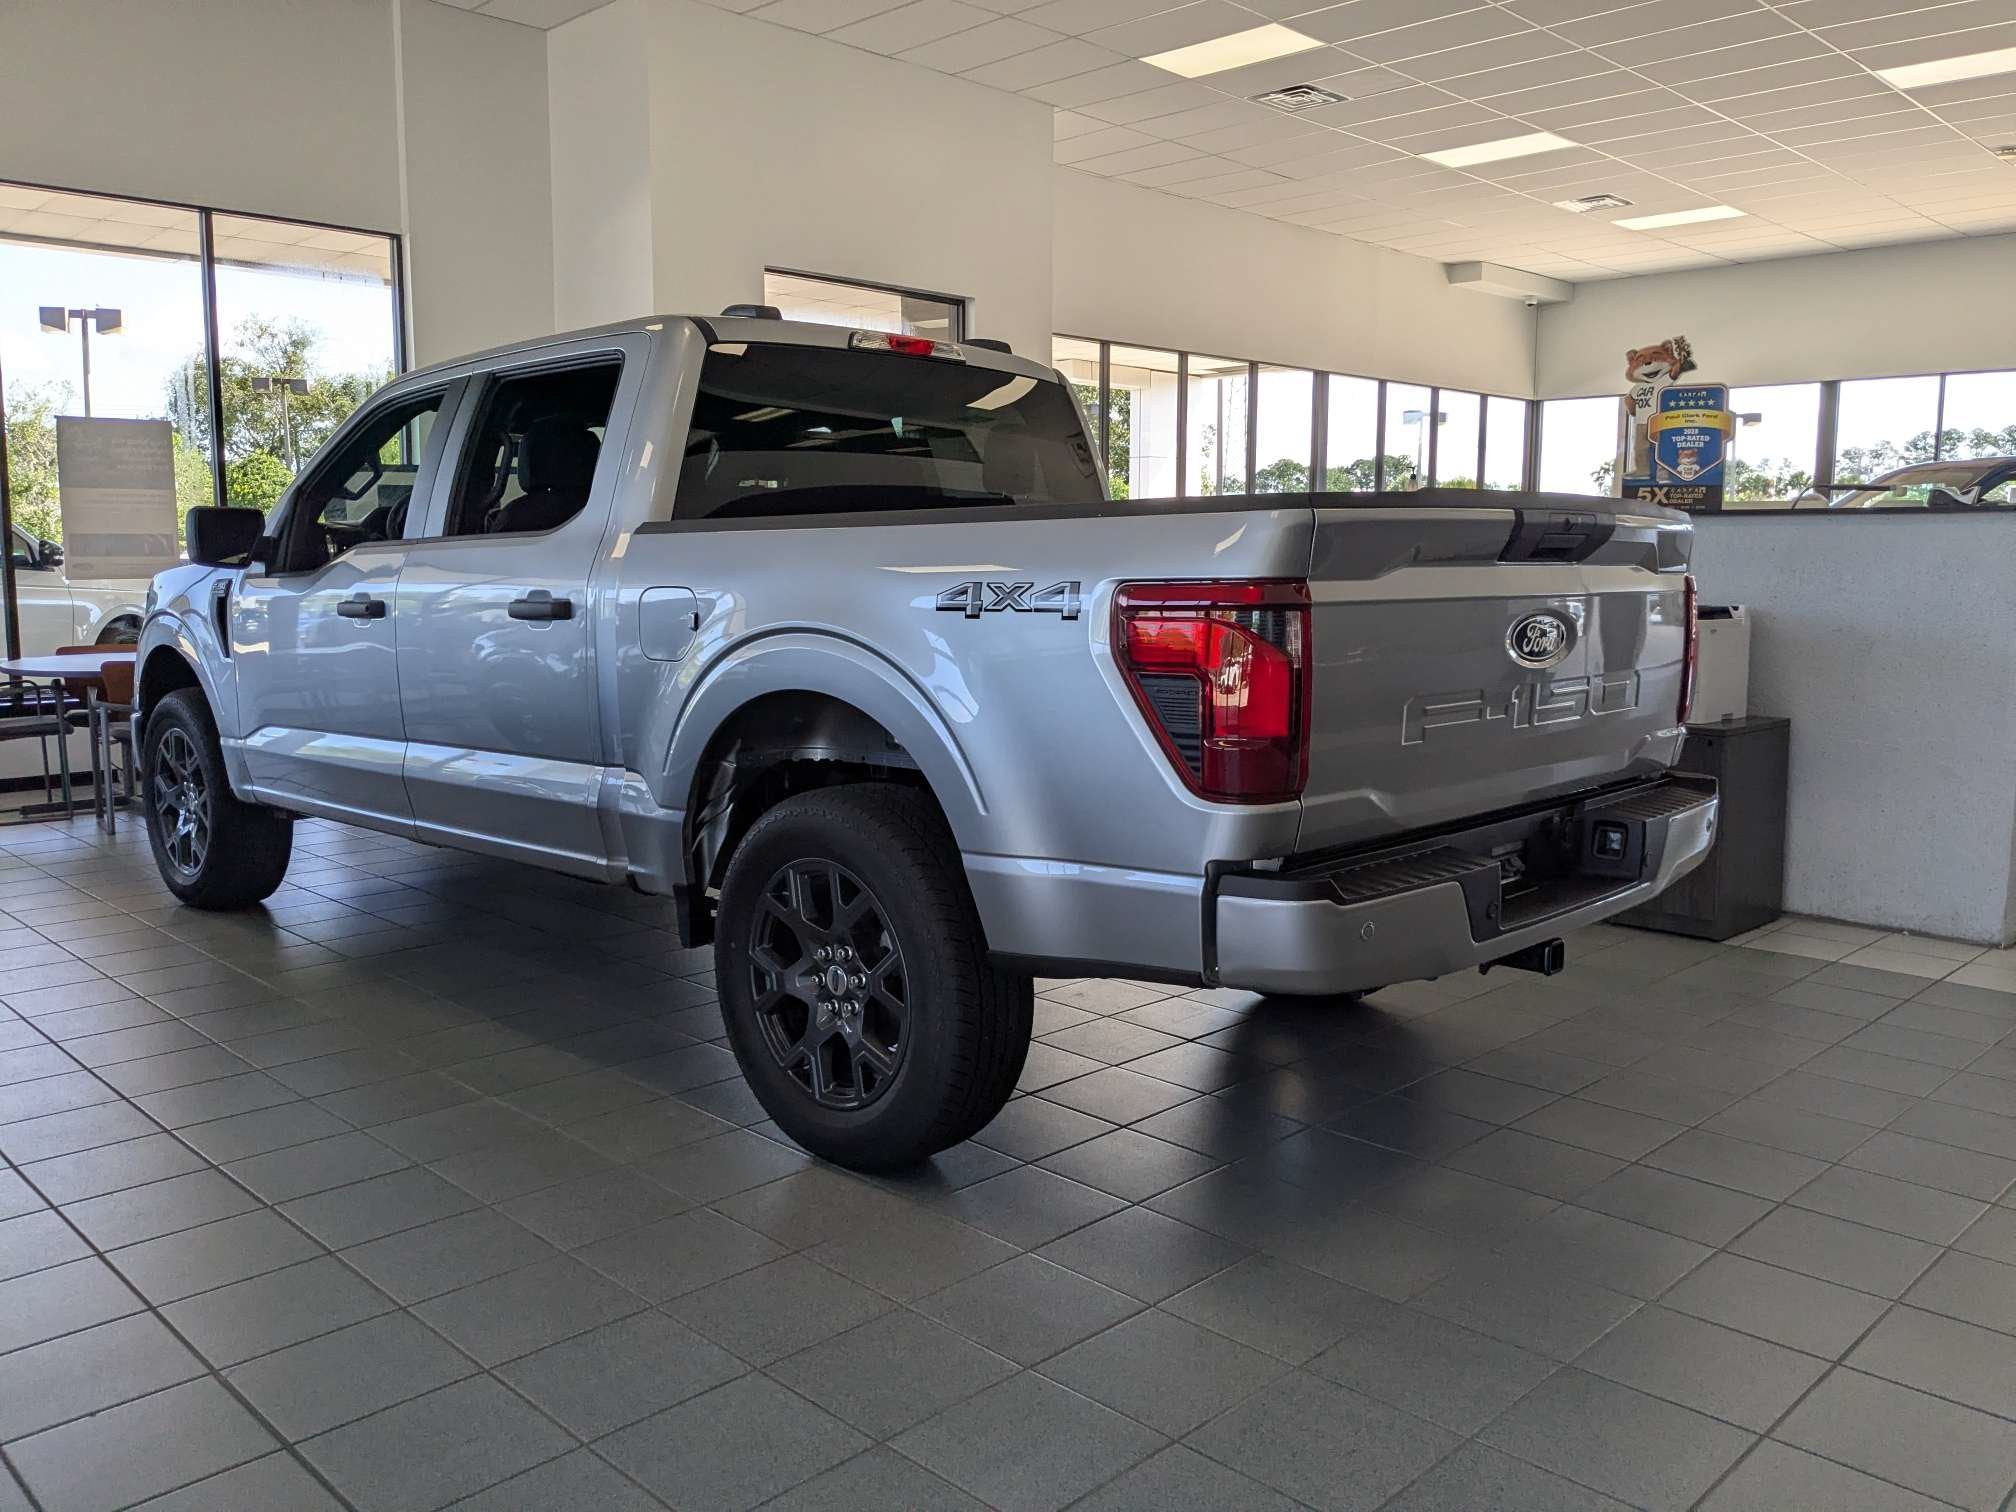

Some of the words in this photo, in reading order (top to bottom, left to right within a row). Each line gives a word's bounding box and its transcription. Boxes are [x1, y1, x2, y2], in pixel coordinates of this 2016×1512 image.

[1637, 386, 1654, 397] CAR
[1634, 398, 1652, 408] FOX
[1637, 487, 1668, 504] 5X
[1522, 623, 1557, 653] Ford
[1401, 669, 1640, 746] F-150
